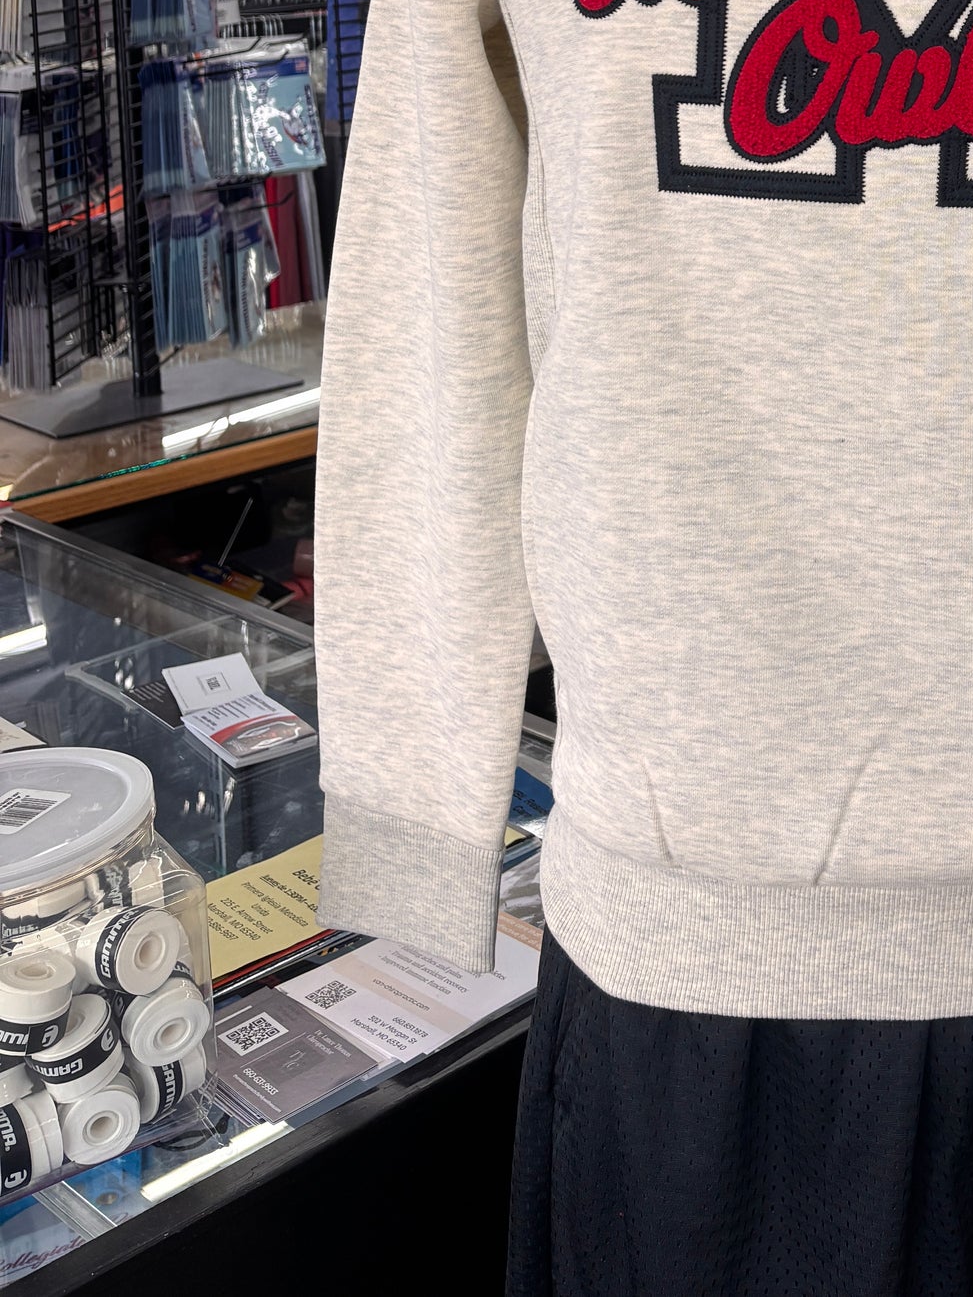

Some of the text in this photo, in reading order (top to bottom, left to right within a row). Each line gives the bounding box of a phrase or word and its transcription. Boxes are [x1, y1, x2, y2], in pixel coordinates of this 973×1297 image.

[241, 881, 265, 898] Primera
[260, 895, 281, 910] Iglesia
[279, 906, 309, 928] Metodista
[251, 902, 270, 917] Unida
[220, 897, 234, 907] 225
[237, 908, 257, 924] Arrow
[252, 920, 274, 934] Street
[228, 918, 244, 930] MO
[239, 926, 261, 941] 65340
[350, 1017, 408, 1052] Marshall, MO 65340
[378, 1020, 392, 1030] W
[384, 1024, 411, 1042] Morgan
[409, 1037, 419, 1045] St
